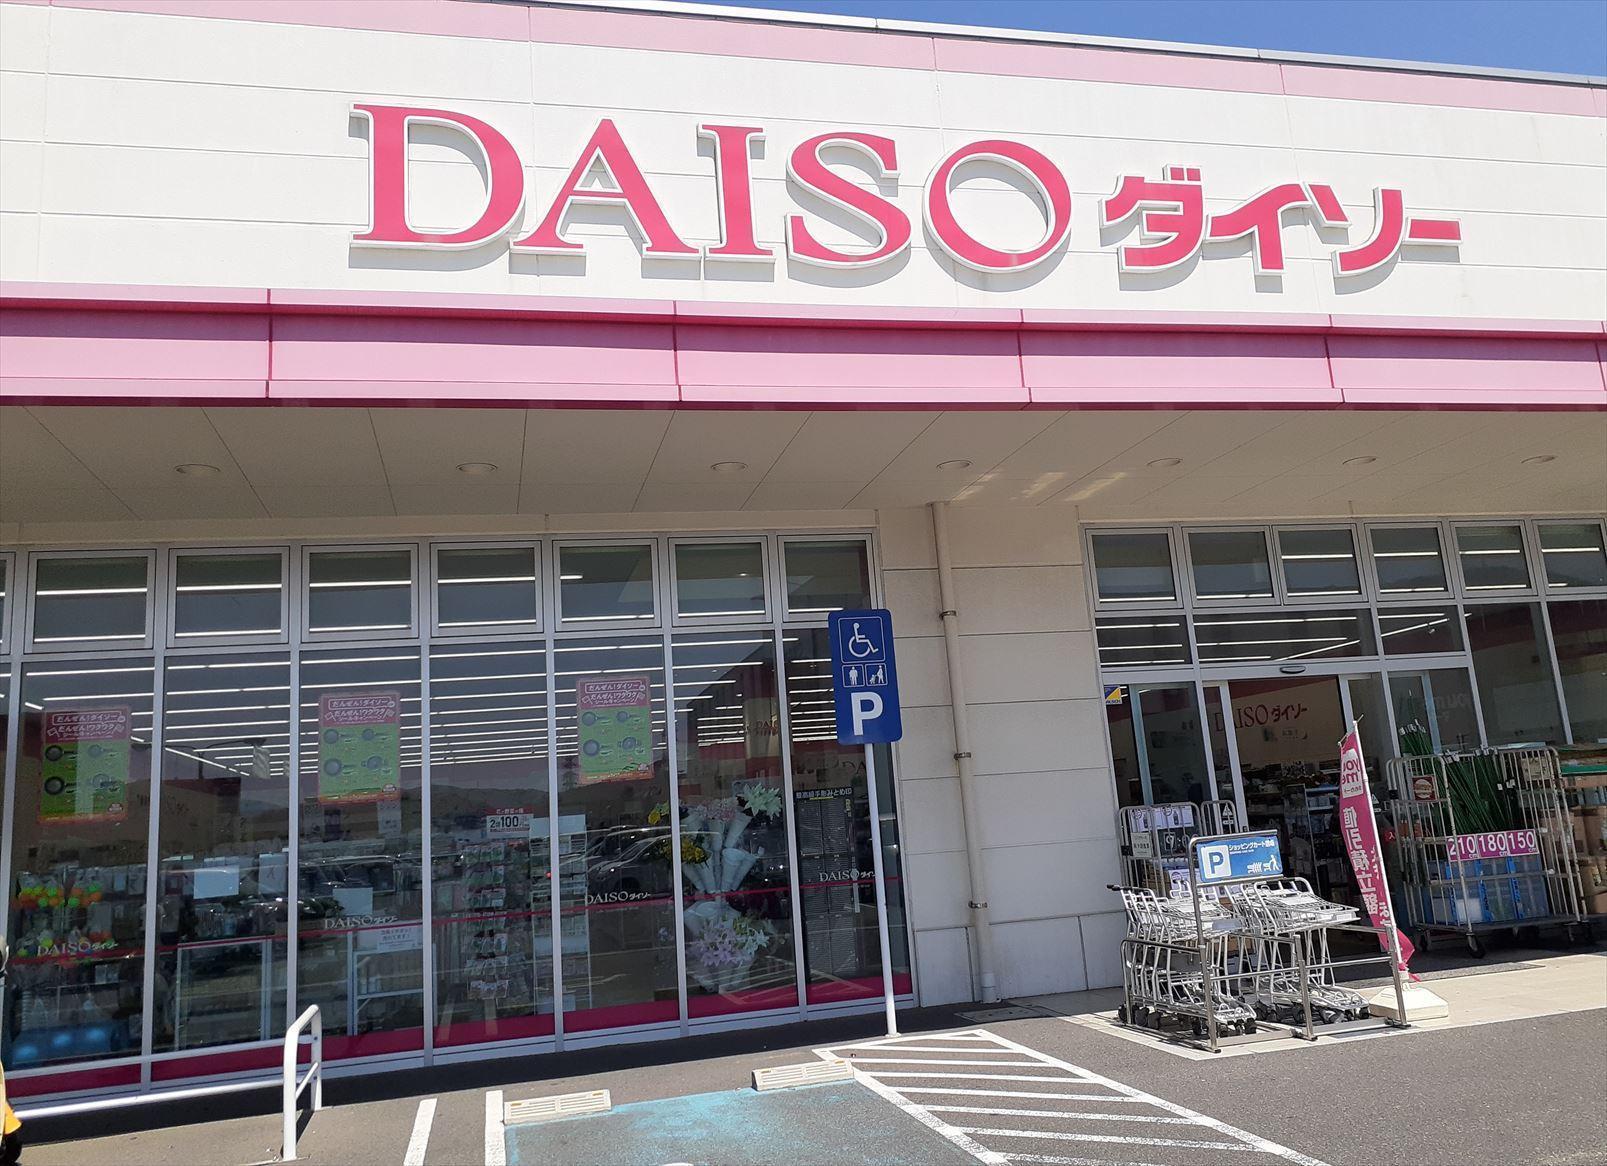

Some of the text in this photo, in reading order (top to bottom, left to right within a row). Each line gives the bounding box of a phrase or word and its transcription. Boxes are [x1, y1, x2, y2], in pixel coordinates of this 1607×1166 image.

[352, 103, 1462, 275] DAISO ダイソー
[850, 691, 884, 736] P
[1271, 703, 1308, 723] ダイソー
[1447, 836, 1476, 856] 210
[1478, 833, 1506, 853] 180
[1508, 831, 1535, 850] 150
[1208, 851, 1224, 875] P
[818, 867, 860, 882] DAISO
[584, 890, 651, 906] DAISO ダイソー
[323, 914, 373, 929] DAISO
[37, 941, 91, 957] DAISO
